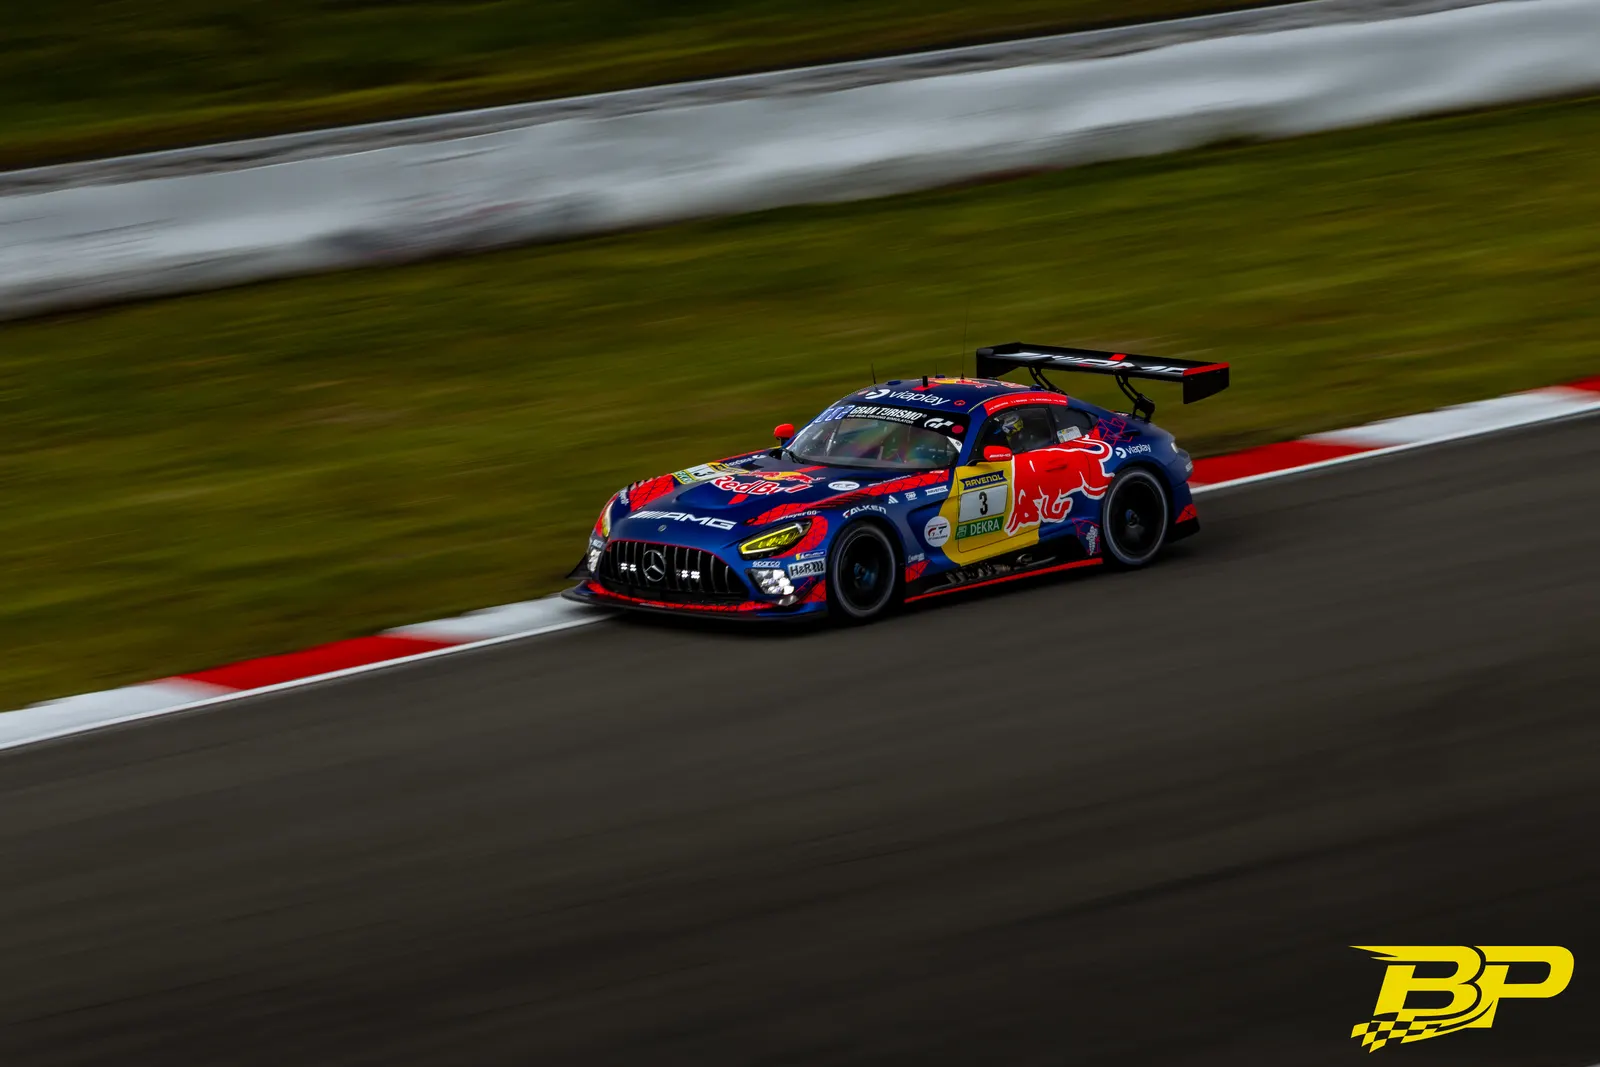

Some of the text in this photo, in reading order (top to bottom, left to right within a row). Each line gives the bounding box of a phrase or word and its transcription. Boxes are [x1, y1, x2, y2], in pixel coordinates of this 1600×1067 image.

[889, 390, 950, 406] viaplay
[850, 406, 923, 421] GRAN TURISMO
[887, 416, 914, 424] SIMULATOR
[1125, 444, 1152, 455] viaplay
[711, 475, 765, 493] Red
[964, 474, 1003, 487] RAVENOL
[978, 491, 988, 515] 3
[842, 504, 887, 518] FALKEN
[658, 511, 737, 531] AMG
[970, 518, 1000, 535] DEKRA
